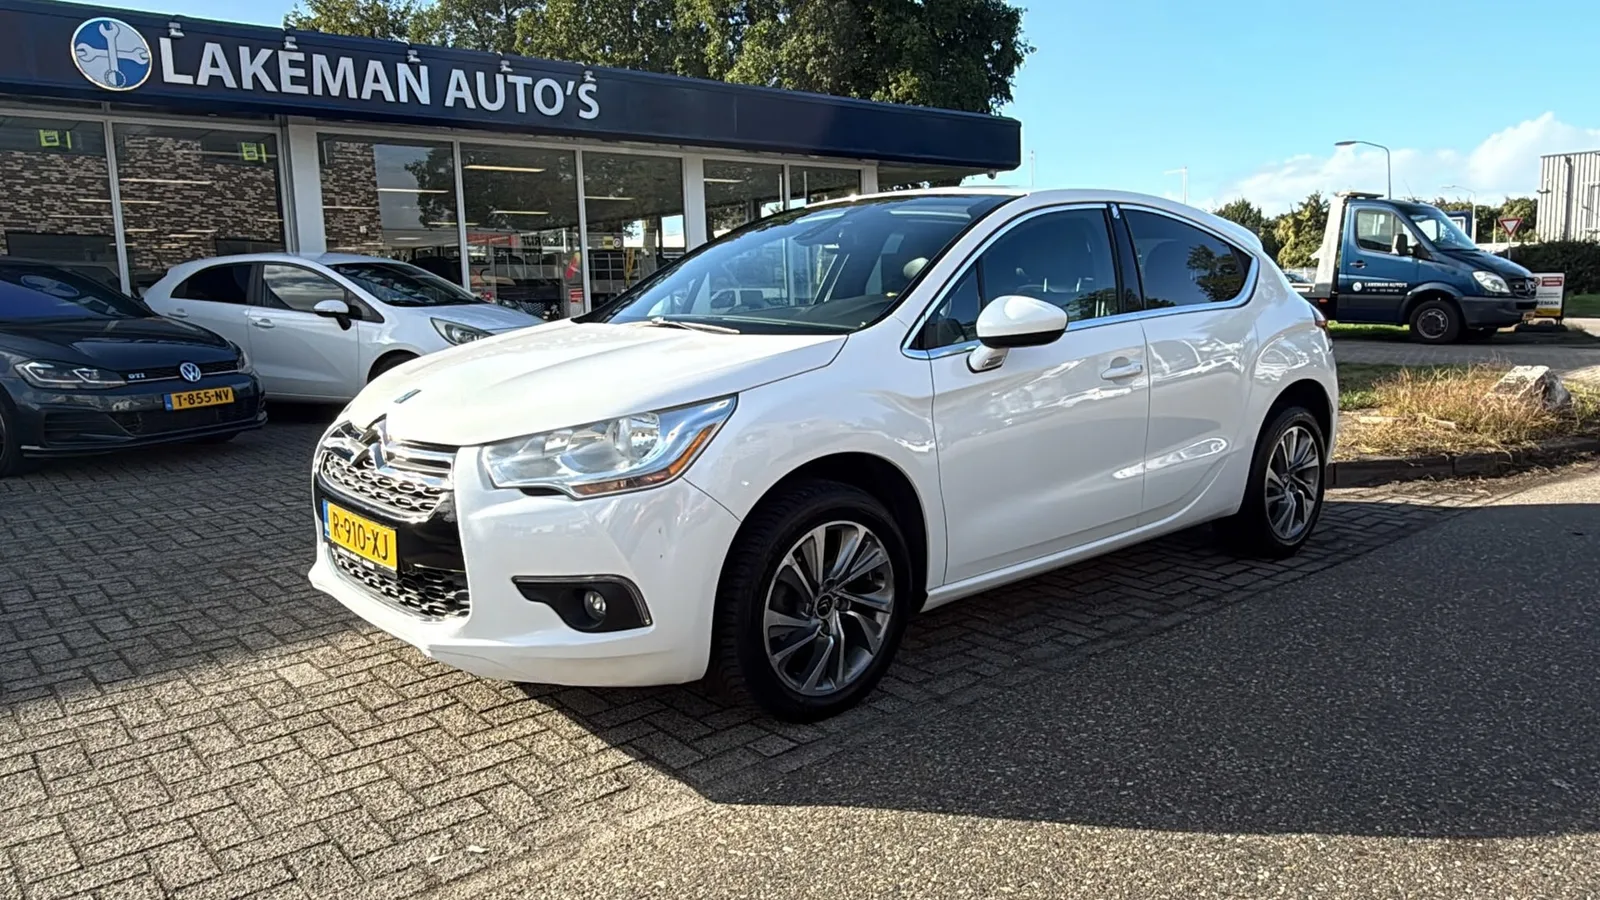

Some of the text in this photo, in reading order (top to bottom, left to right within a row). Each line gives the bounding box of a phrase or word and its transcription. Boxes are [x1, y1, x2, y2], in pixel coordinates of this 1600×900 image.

[158, 37, 600, 120] LAKEMAN AUTO'S
[128, 372, 146, 380] GTI
[175, 389, 230, 407] T-855-NV
[332, 511, 389, 561] R-910-XJ
